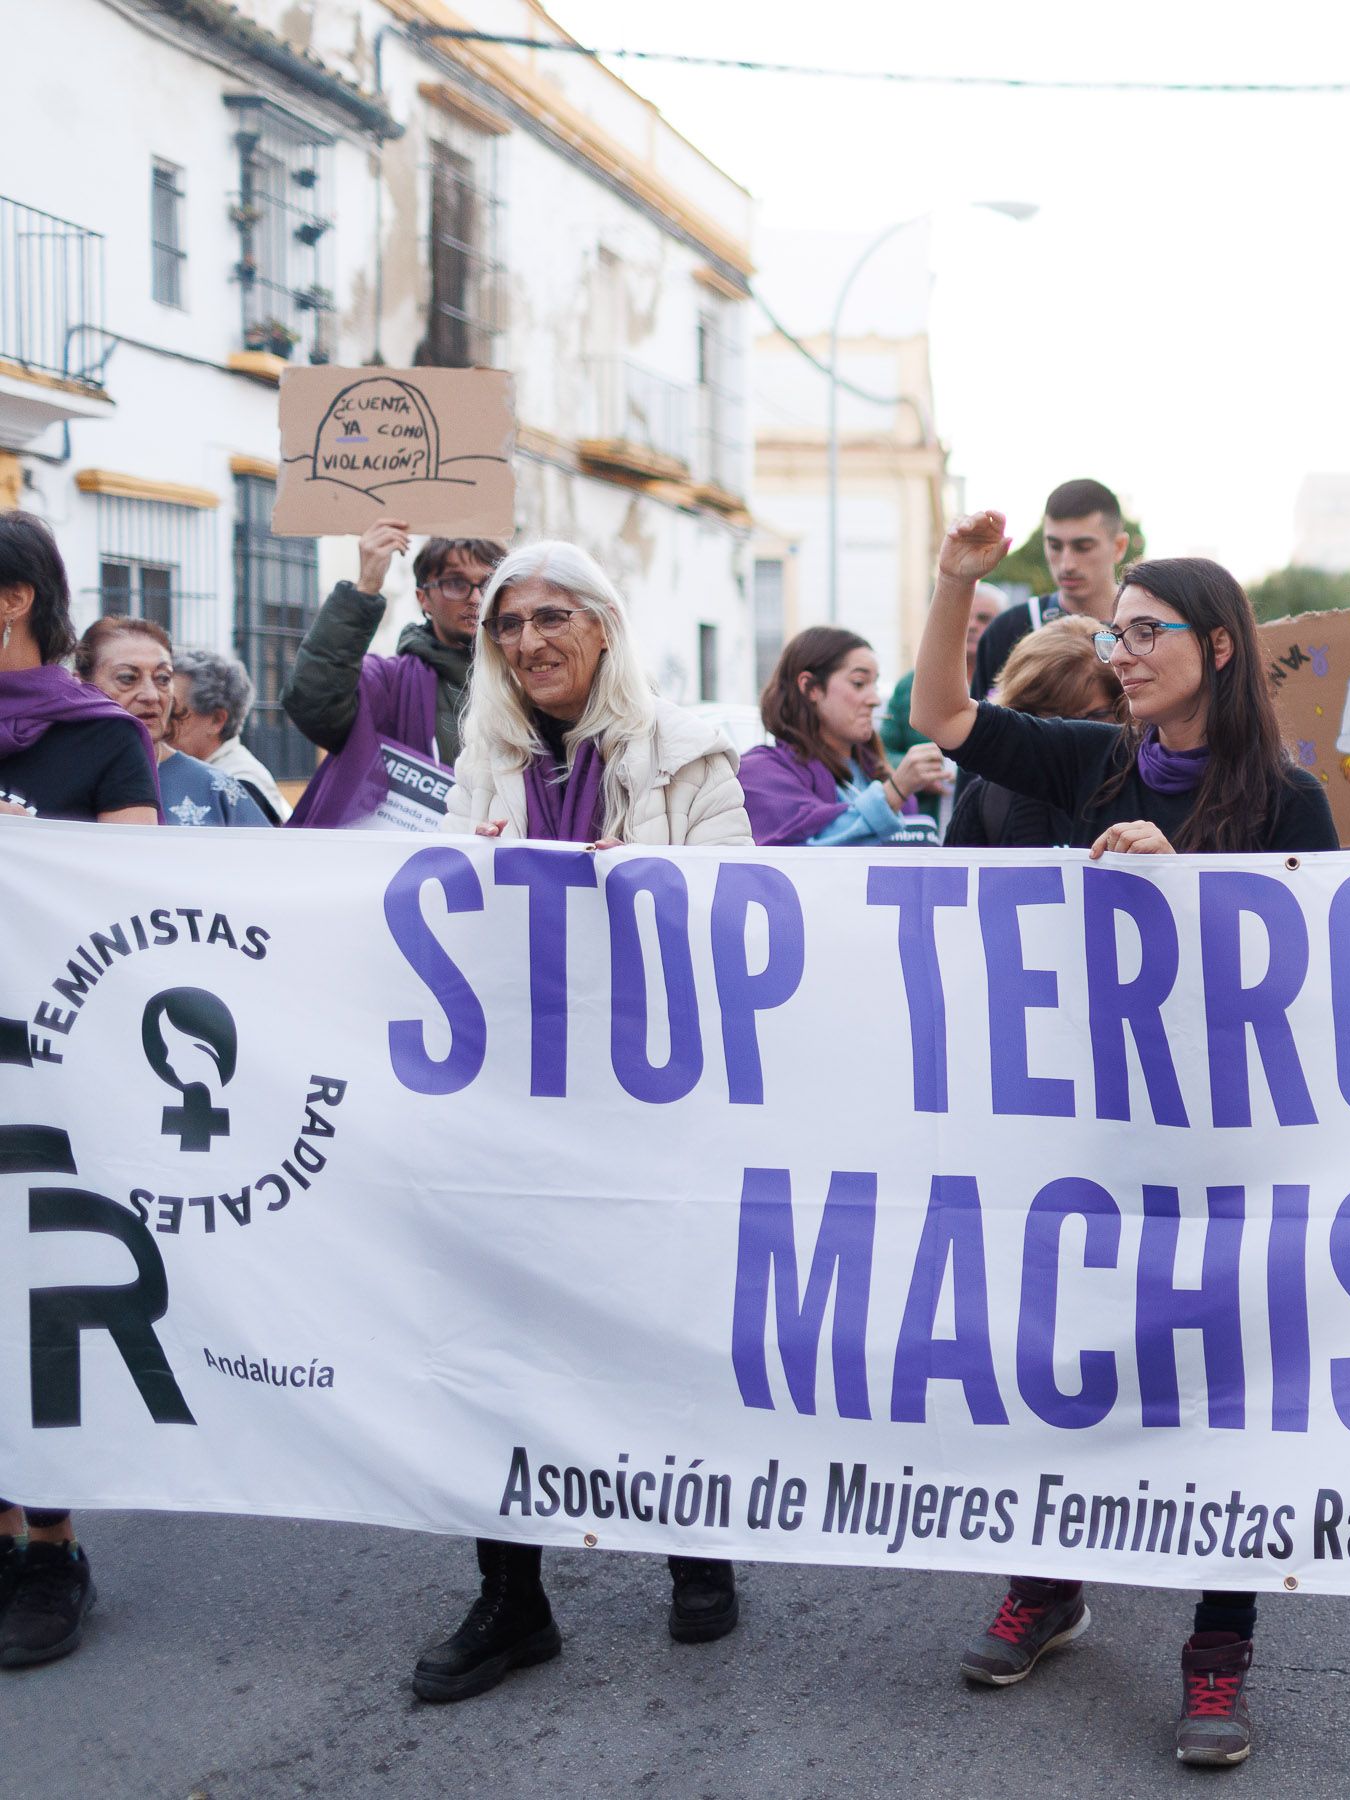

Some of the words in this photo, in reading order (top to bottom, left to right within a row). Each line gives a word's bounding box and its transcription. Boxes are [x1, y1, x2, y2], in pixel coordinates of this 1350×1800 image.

[333, 396, 411, 420] ¿CUENTA
[342, 419, 361, 435] YA
[377, 423, 424, 439] COMO
[322, 448, 426, 475] VIOLACIÓN?
[383, 755, 449, 801] MERCE
[30, 908, 271, 1064] FEMINISTAS
[383, 846, 805, 1105] STOP
[129, 1074, 347, 1235] RADICALES
[203, 1347, 335, 1388] Andalucía
[500, 1446, 732, 1528] Asocición
[747, 1459, 807, 1531] de
[822, 1462, 1019, 1554] Mujeres
[1032, 1473, 1295, 1560] Feministas
